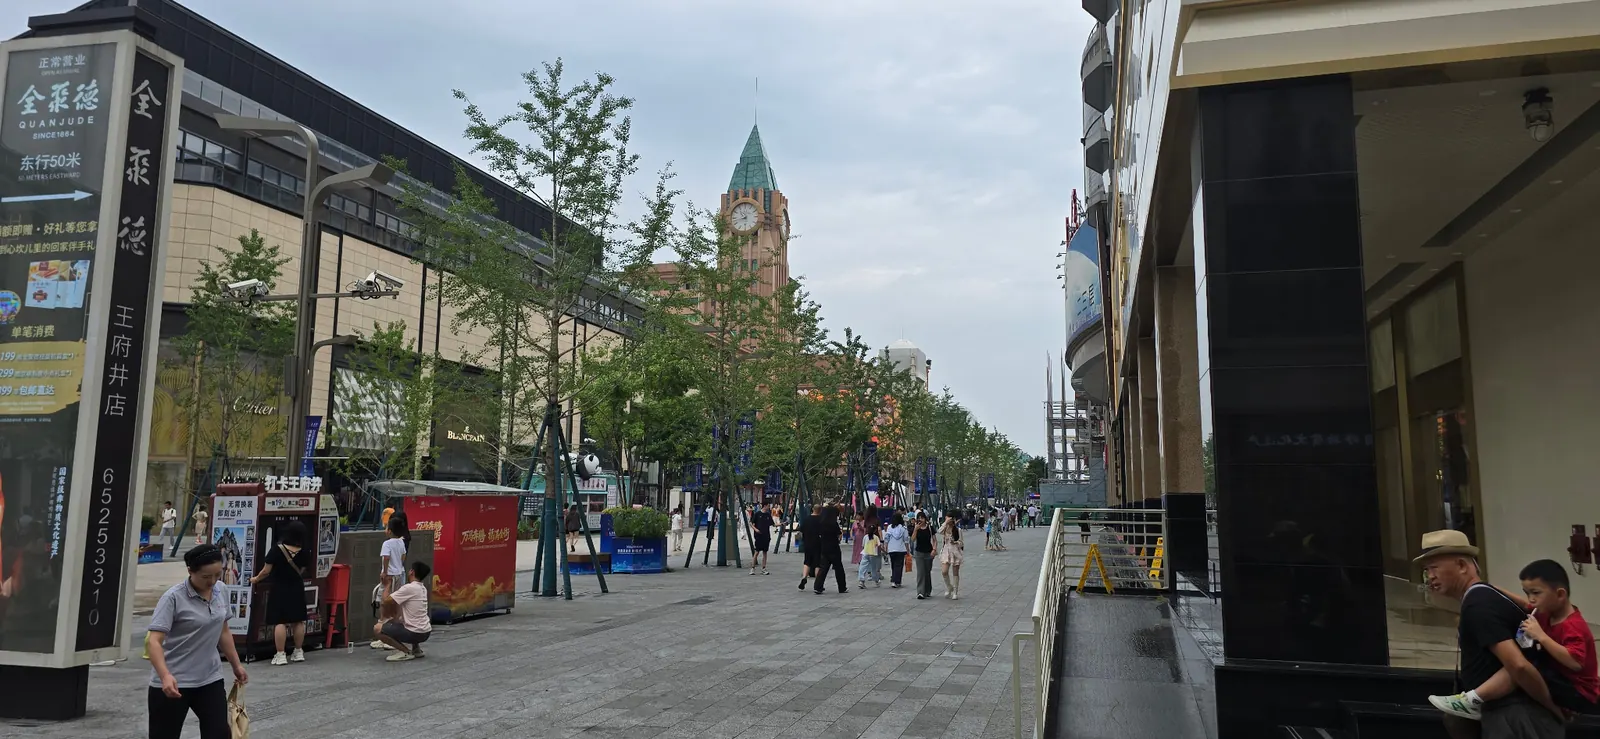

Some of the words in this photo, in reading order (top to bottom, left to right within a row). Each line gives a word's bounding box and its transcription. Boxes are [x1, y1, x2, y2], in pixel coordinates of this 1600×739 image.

[38, 53, 87, 69] 正常营业
[19, 116, 94, 129] QUANJUDE
[20, 152, 82, 171] 东行50米
[11, 325, 55, 338] 单笔消费
[104, 304, 134, 417] 王府井店
[232, 395, 278, 416] Cartier
[447, 430, 485, 443] BLANCPAIN
[264, 475, 323, 492] 打卡王府井
[228, 500, 254, 508] 无需换装
[50, 466, 67, 559] 国家级非物质文化遗产
[217, 509, 243, 517] 即刻出片
[88, 467, 114, 626] 65253310
